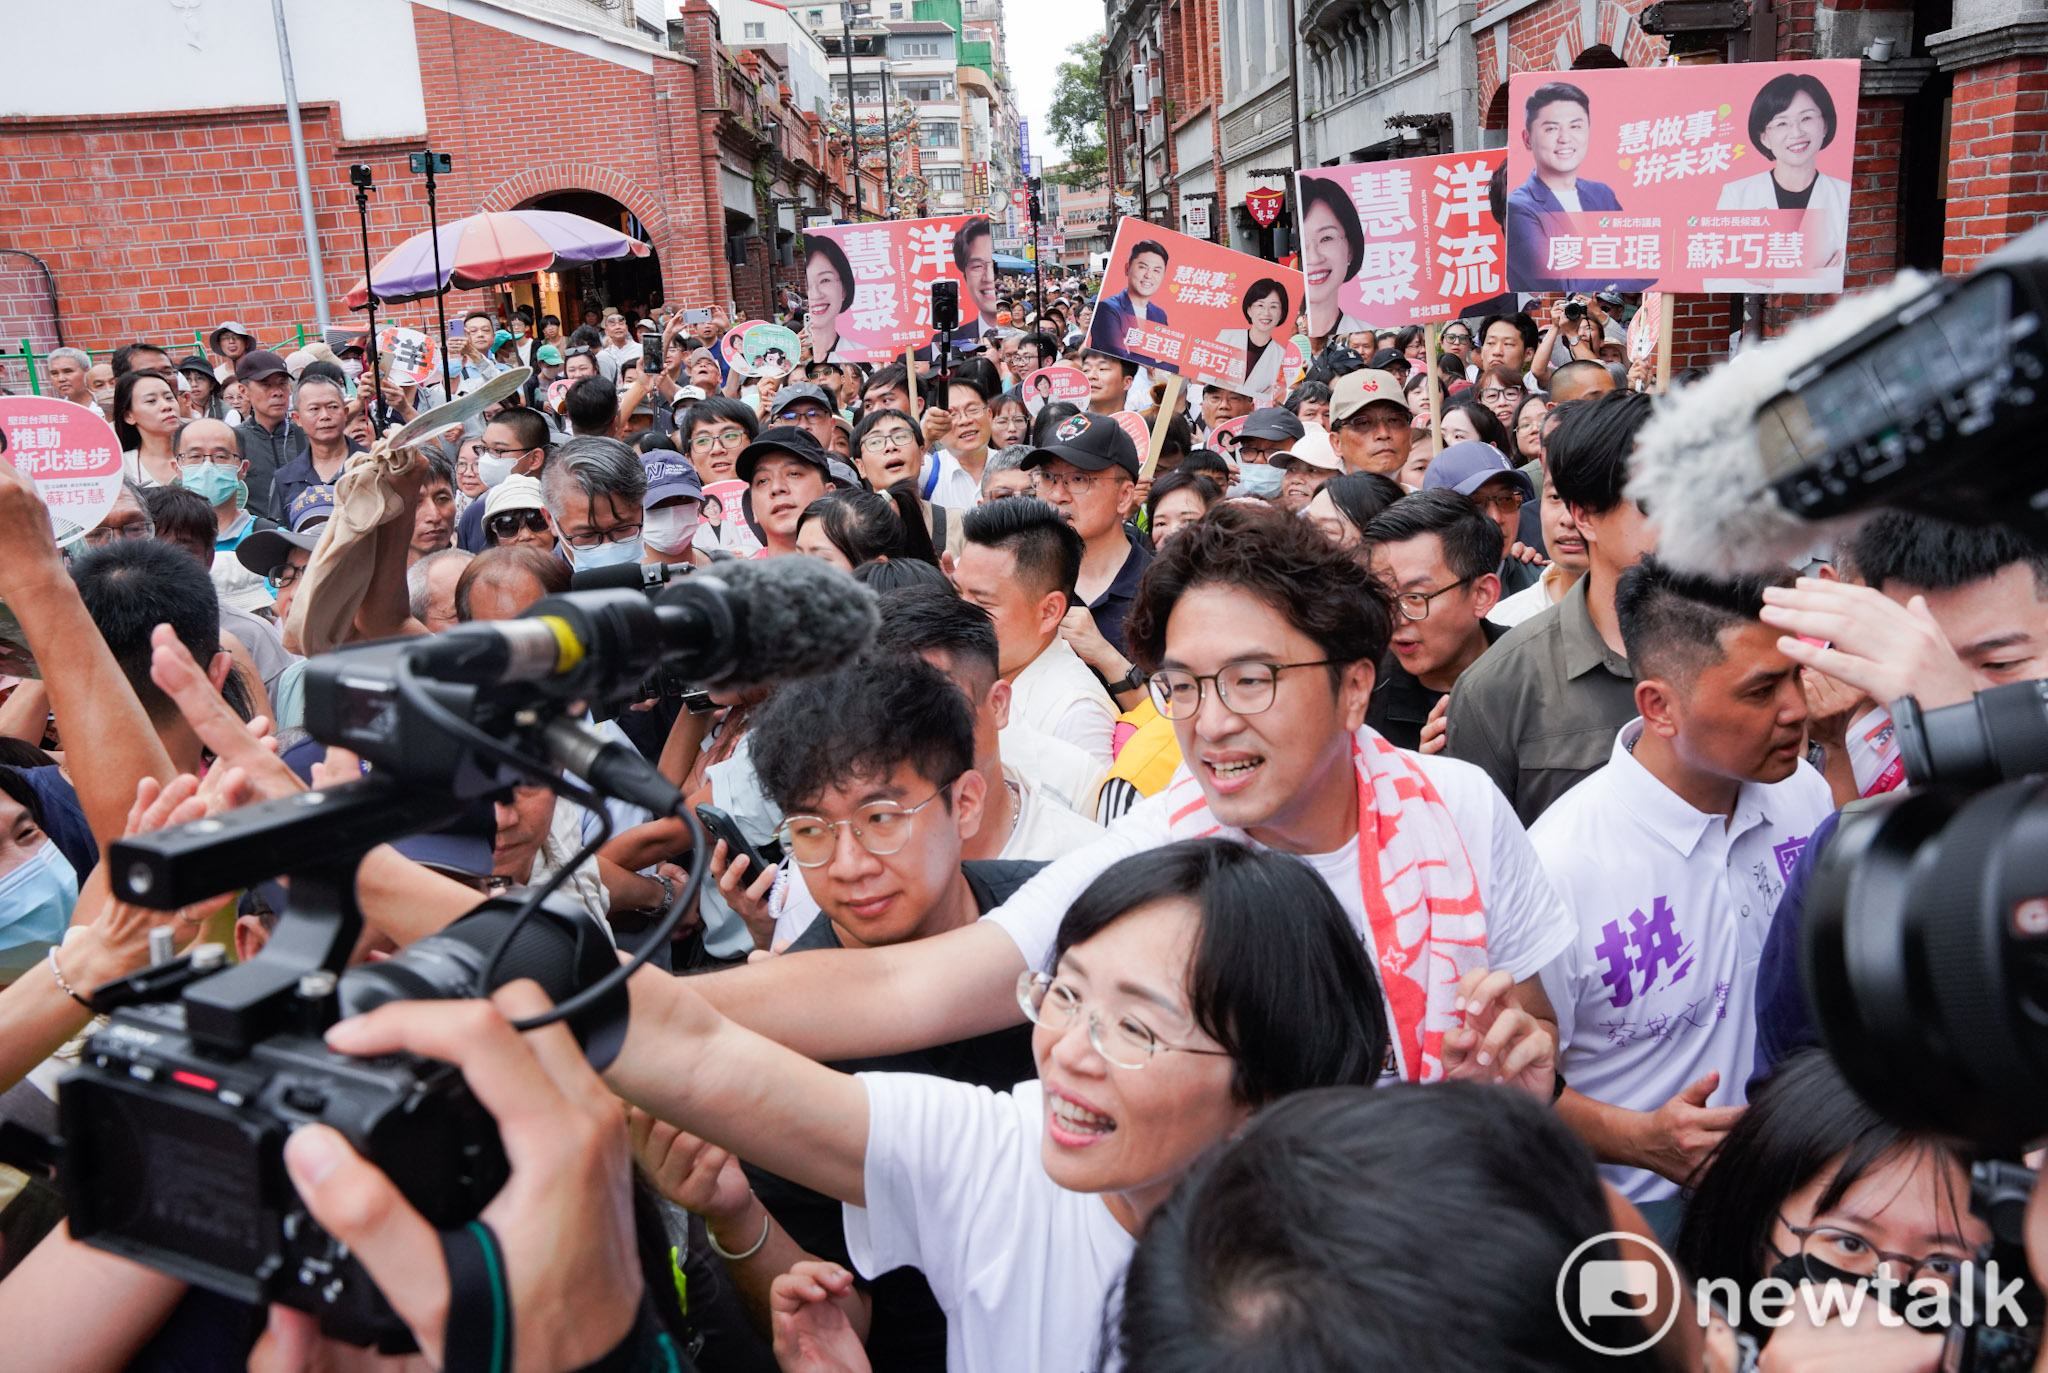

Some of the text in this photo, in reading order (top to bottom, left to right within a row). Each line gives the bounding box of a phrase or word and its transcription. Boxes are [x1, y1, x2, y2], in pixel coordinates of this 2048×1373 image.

[1616, 109, 1718, 154] 慧做事
[1433, 160, 1500, 298] 洋流
[1612, 216, 1661, 228] 新北市議員
[1700, 215, 1771, 227] 新北市長候選人
[1351, 168, 1420, 306] 慧聚
[1686, 231, 1804, 269] 蘇巧慧
[1547, 234, 1661, 271] 廖宜琨
[843, 229, 899, 331] 慧聚
[1173, 265, 1230, 291] 慧做事
[1410, 304, 1452, 319] 雙北雙贏
[1123, 327, 1182, 360] 廖宜琨
[1188, 346, 1243, 378] 蘇巧慧
[8, 413, 69, 425] 堅定台灣民主
[11, 427, 61, 450] 推動
[14, 447, 111, 473] 新北進步
[46, 488, 105, 506] 蘇巧慧
